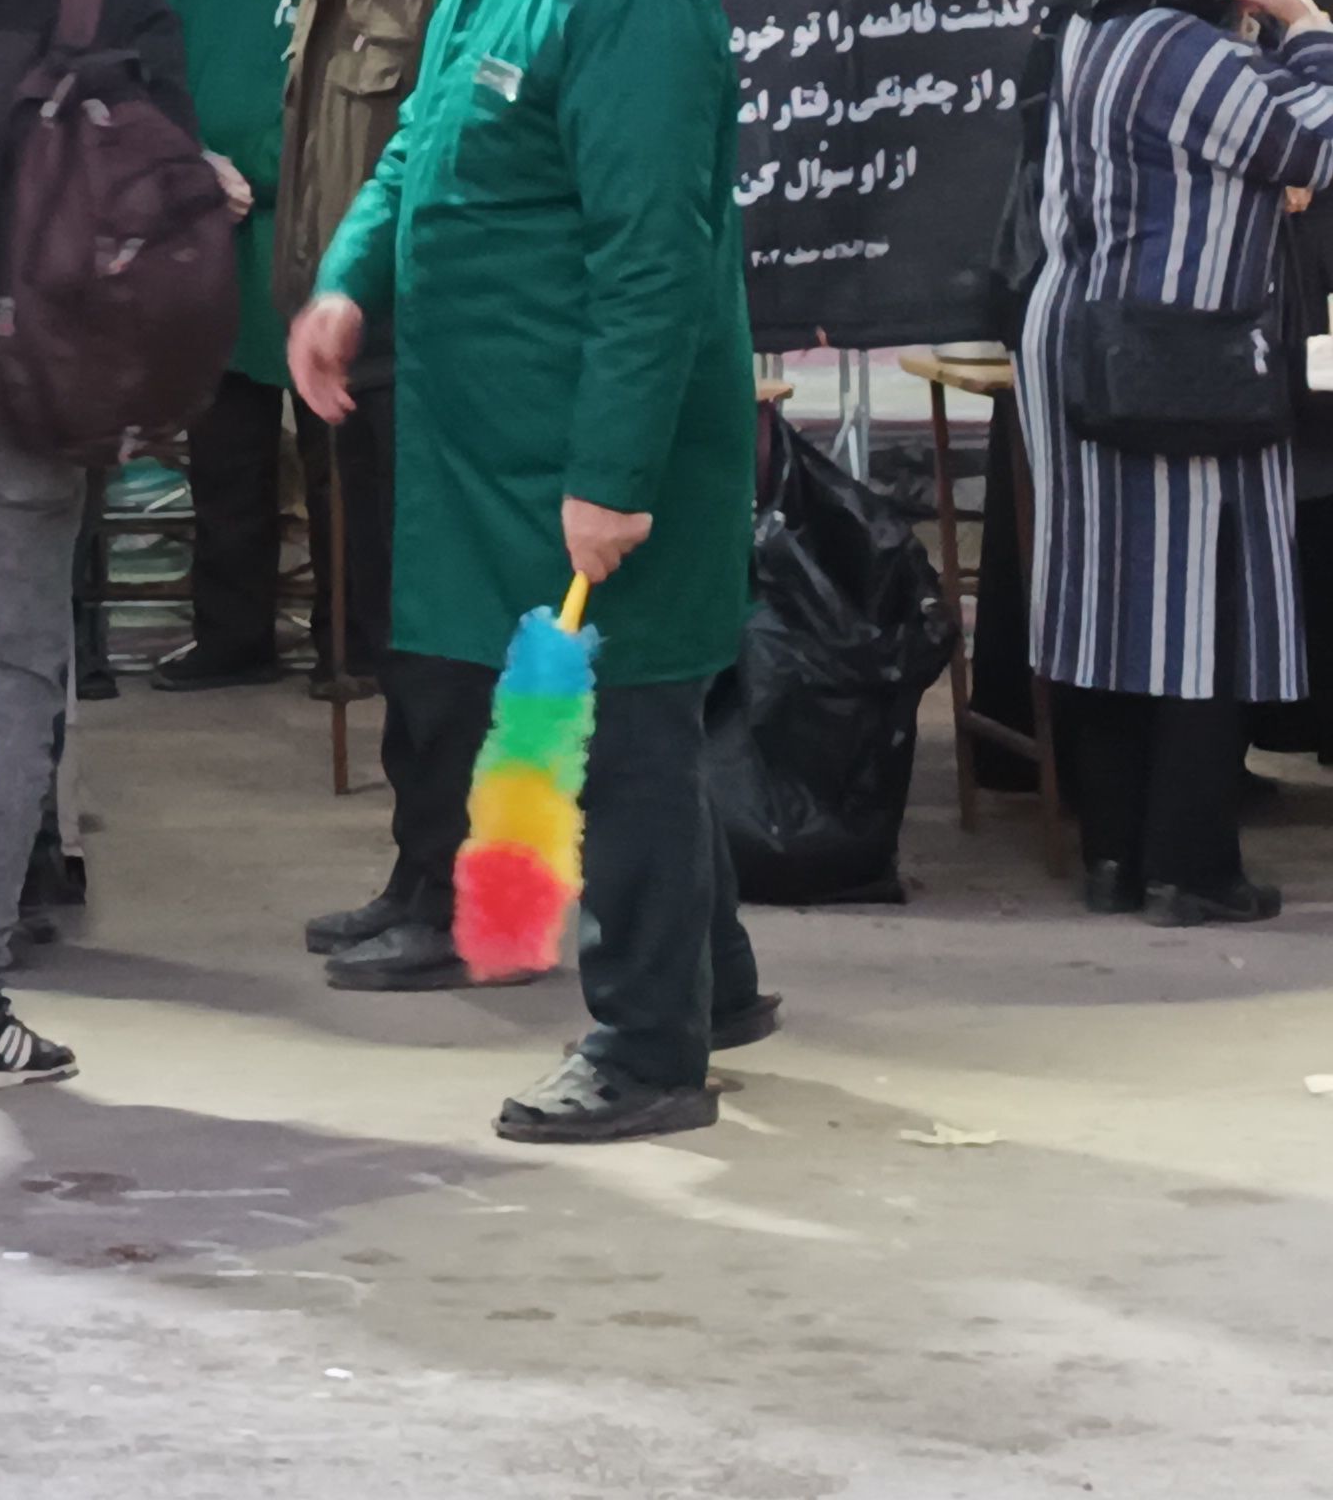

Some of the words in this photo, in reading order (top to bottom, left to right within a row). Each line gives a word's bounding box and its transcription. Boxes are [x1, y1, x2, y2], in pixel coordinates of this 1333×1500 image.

[729, 15, 785, 63] خود
[790, 11, 822, 58] تو
[826, 10, 855, 53] را
[772, 81, 844, 132] رفتار
[848, 72, 959, 124] چگونگی
[963, 68, 994, 113] از
[996, 78, 1017, 111] و
[733, 160, 782, 206] کن
[857, 148, 885, 195] او
[887, 145, 918, 191] از
